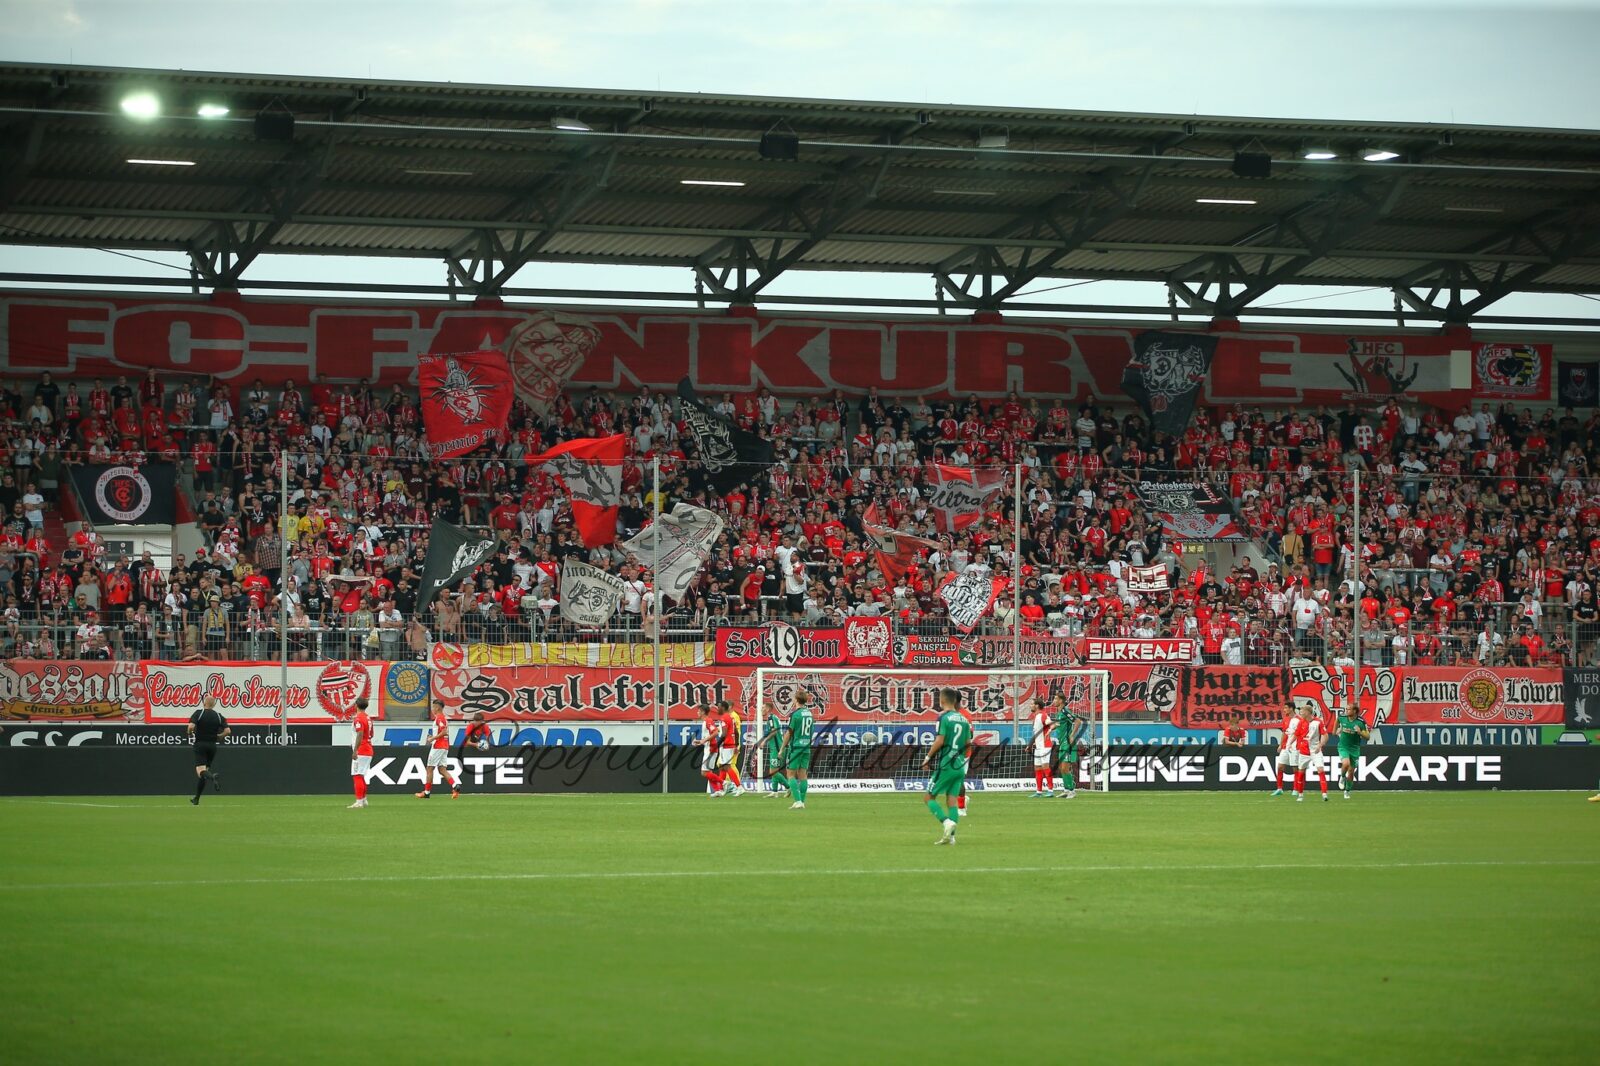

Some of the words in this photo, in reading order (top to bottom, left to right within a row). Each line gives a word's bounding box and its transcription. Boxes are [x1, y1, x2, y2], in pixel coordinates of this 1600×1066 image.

[1362, 343, 1395, 354] HFC
[1129, 565, 1167, 583] HFC
[910, 643, 957, 651] MANSFELD
[918, 635, 949, 643] SEKTION
[469, 643, 588, 667] BULLEN
[913, 653, 953, 664] SÜDHARZ
[979, 639, 1071, 664] Pyrmanie
[1089, 642, 1192, 660] SURREALE
[1292, 668, 1322, 684] HFC
[1462, 670, 1501, 688] HALLESCHER
[461, 675, 730, 713] Saalefront
[1405, 676, 1459, 702] Leuna
[1504, 677, 1564, 704] Löwen
[1441, 706, 1462, 719] seit
[801, 716, 813, 737] 18
[224, 732, 262, 745] sucht
[952, 723, 963, 749] 2
[1396, 728, 1537, 746] AUTOMATION
[362, 757, 524, 785] KARTE
[1079, 756, 1205, 782] DEINE
[1218, 755, 1502, 782] DAERKARTE
[843, 782, 859, 790] die
[860, 782, 893, 792] Region
[903, 781, 924, 791] PS
[986, 782, 1021, 792] bewegt
